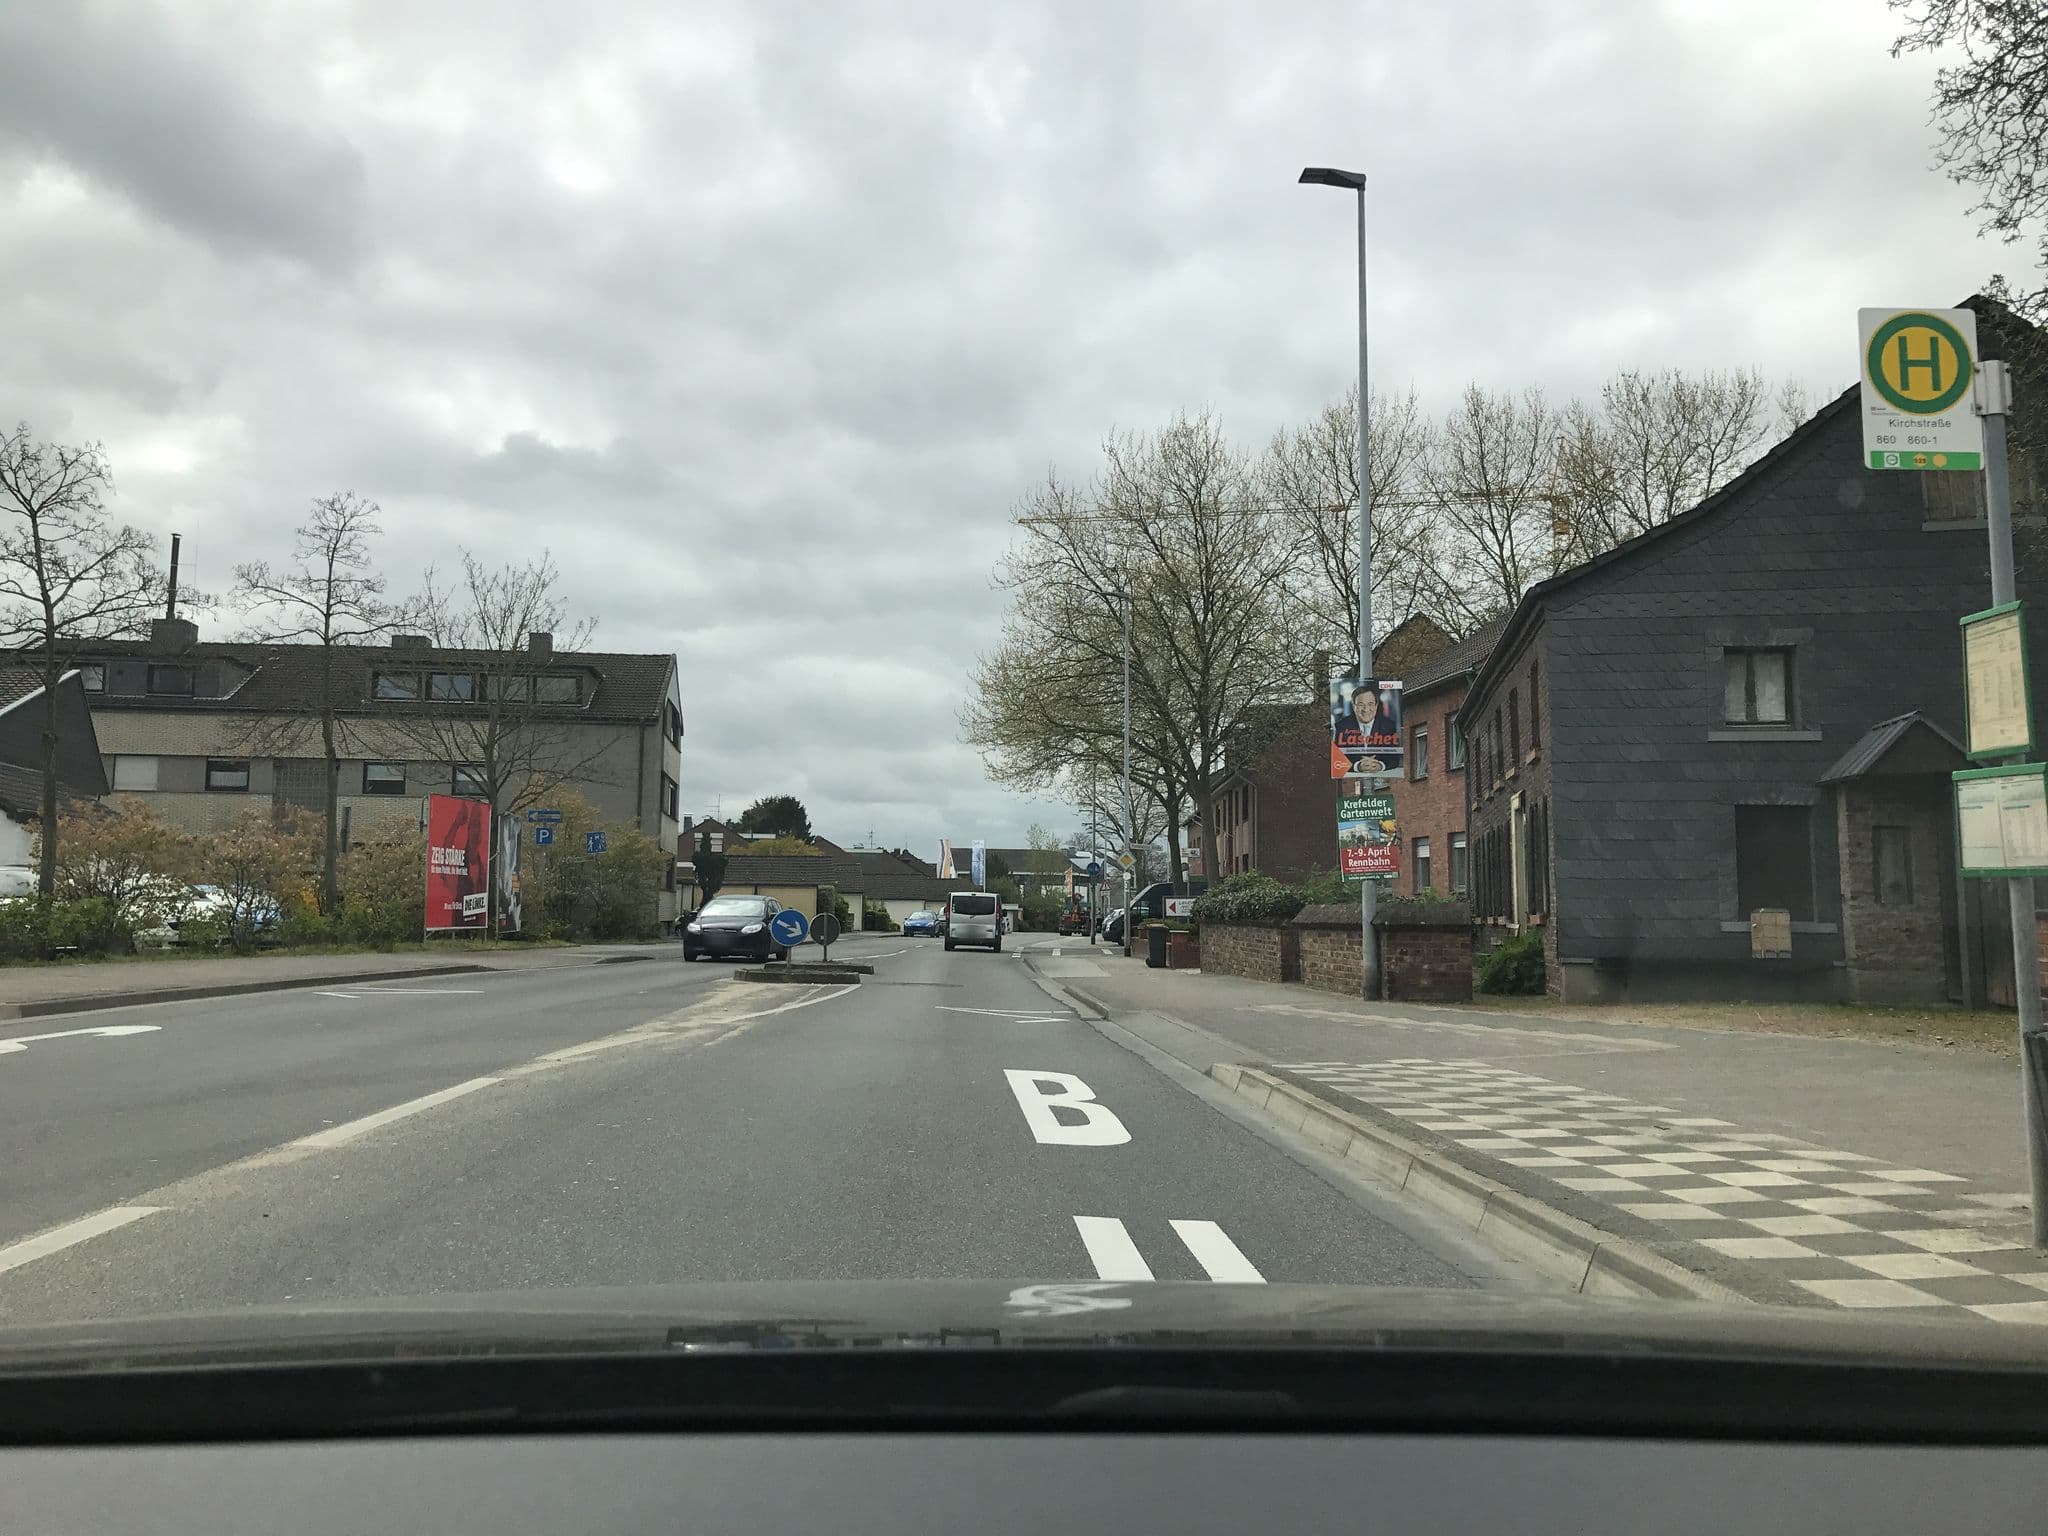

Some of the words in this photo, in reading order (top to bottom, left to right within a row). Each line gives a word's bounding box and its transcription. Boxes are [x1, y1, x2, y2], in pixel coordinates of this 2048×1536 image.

[1898, 336, 1941, 391] H
[1889, 419, 1951, 428] Kirchstraße
[1876, 435, 1896, 444] 860
[1907, 435, 1938, 445] 860-1
[1337, 732, 1399, 745] Laschet
[1343, 798, 1387, 809] Krefelder
[1340, 807, 1393, 818] Gartenwelt
[539, 829, 550, 842] P
[431, 846, 445, 864] ZEIG
[1368, 847, 1391, 858] April
[1348, 857, 1391, 867] Rennbahn
[1003, 1069, 1132, 1146] B
